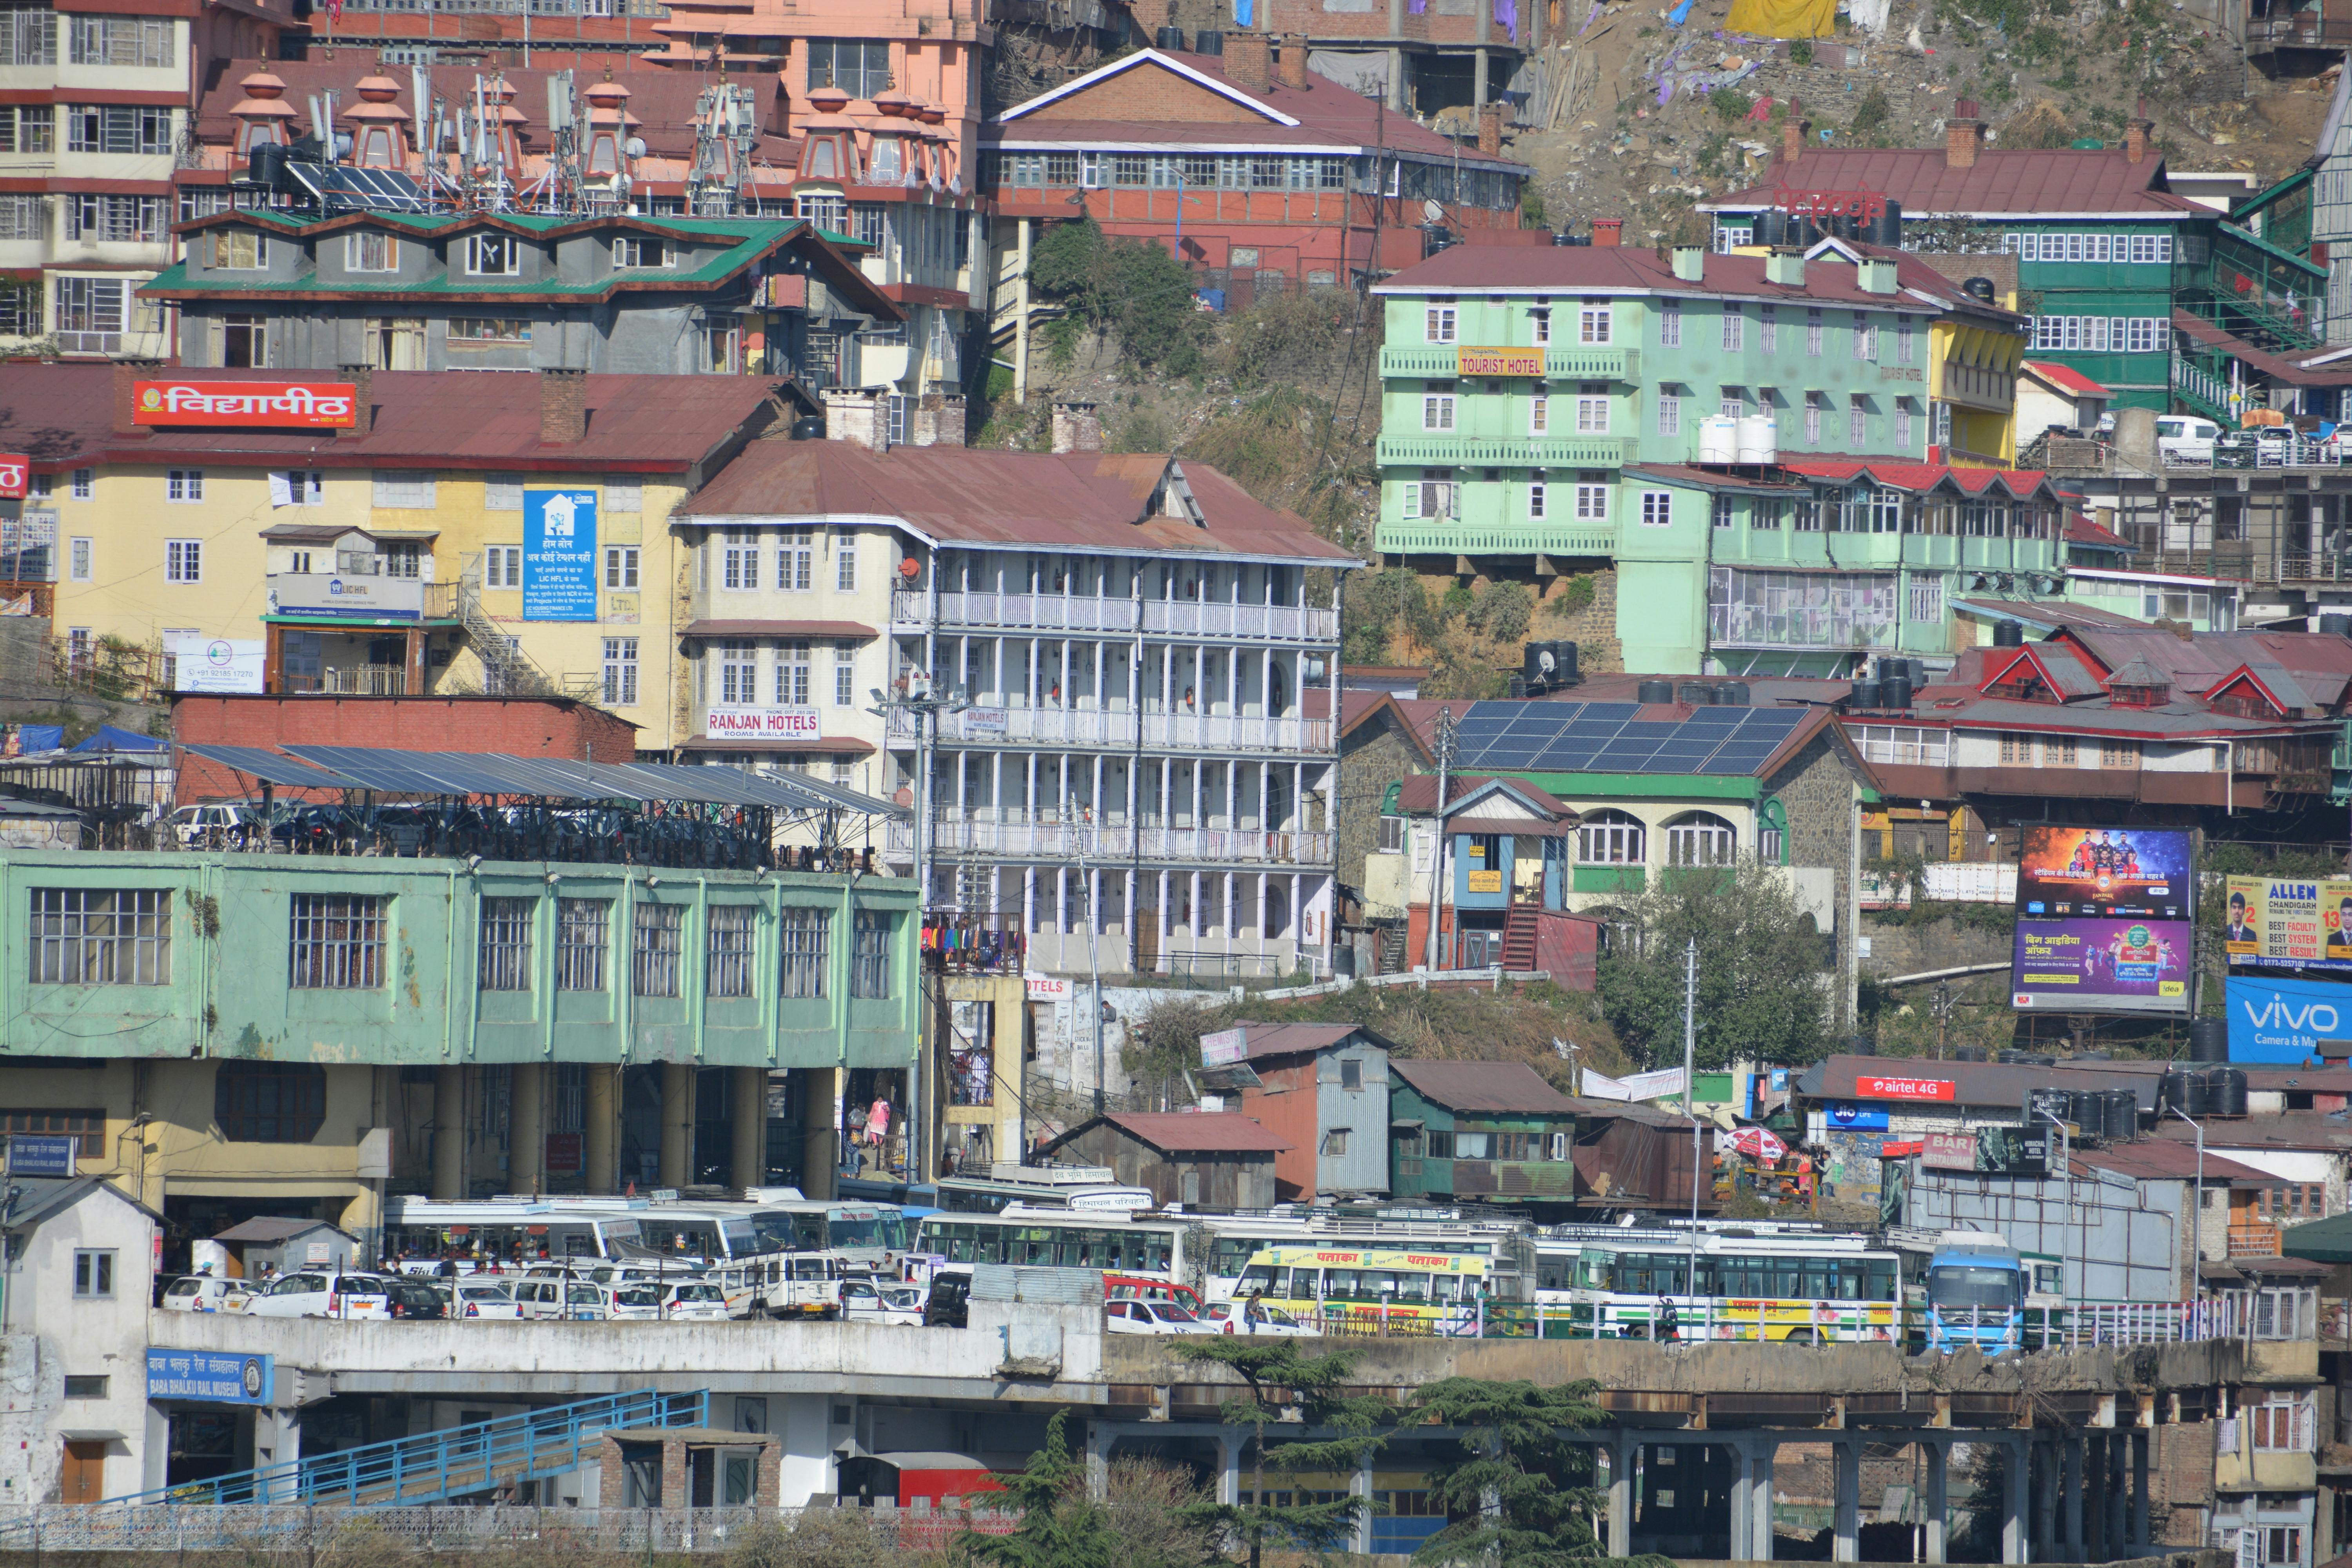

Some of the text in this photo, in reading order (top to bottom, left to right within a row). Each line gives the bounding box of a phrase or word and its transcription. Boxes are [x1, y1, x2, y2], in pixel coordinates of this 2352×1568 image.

[1462, 358, 1540, 373] TOURIST HOTEL
[1906, 368, 1922, 381] HOTEL
[163, 387, 350, 415] विद्यापीठ
[543, 538, 573, 549] होम लोन
[527, 553, 540, 562] अब
[541, 551, 555, 564] कोई
[577, 551, 591, 563] नहीं
[343, 585, 368, 594] LIC HFL
[710, 715, 816, 730] RANJAN HOTELS
[968, 711, 1004, 723] RANJAN HOTELS
[2269, 884, 2316, 901] ALLEN
[2269, 901, 2316, 909] CHANDIGARH
[2245, 906, 2255, 923] 2
[2323, 911, 2339, 927] 13
[2269, 922, 2316, 932] BEST FACULTY
[2025, 934, 2080, 946] बिग आइडिया
[2270, 934, 2317, 944] BEST SYSTEM
[2270, 946, 2317, 957] BEST RESULT
[2264, 959, 2305, 967] 0172-5257100
[1027, 980, 1063, 993] OTELS
[2245, 993, 2338, 1032] vivo
[1201, 1031, 1239, 1048] CHEMISTS
[2255, 1033, 2299, 1046] Camera &
[1885, 1081, 1937, 1094] airtel 4G
[1835, 1105, 1855, 1117] Jio
[1933, 1136, 1967, 1149] BAR
[1923, 1153, 1973, 1166] RESTAURANT
[1054, 1169, 1112, 1181] देव भूमि हिमाचल
[1079, 1198, 1145, 1208] हिमाचल परिवहन
[1317, 1252, 1358, 1262] पताका
[1407, 1255, 1448, 1266] पताका
[408, 1266, 430, 1276] Ski
[149, 1354, 240, 1377] बाबा भलकु रेल संग्रहालय
[150, 1379, 240, 1397] BABA BHALKU RAIL MUSEUM
